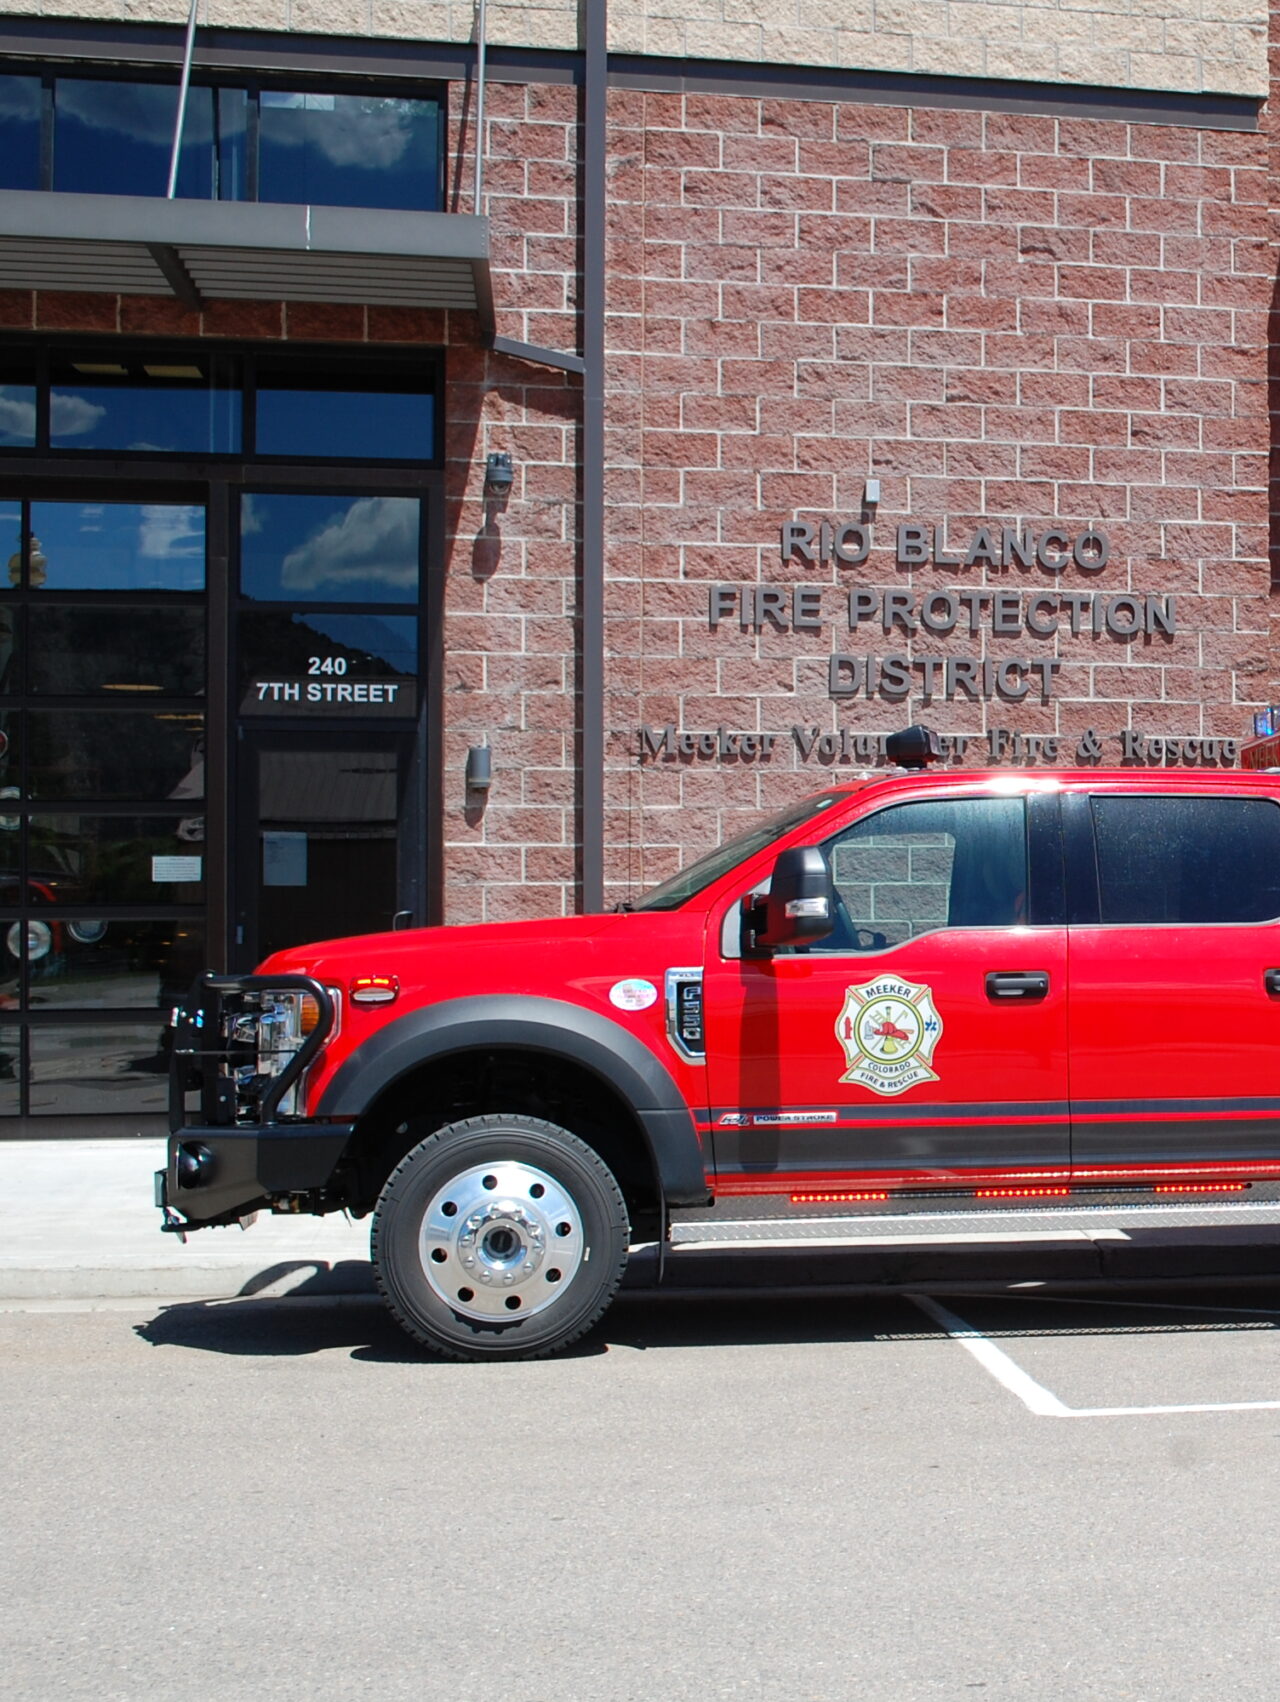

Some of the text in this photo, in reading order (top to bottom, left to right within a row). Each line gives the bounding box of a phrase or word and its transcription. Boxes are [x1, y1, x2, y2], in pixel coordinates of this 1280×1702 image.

[782, 521, 1110, 570] RIO BLANCO
[708, 585, 1178, 636] FIRE PROTECTION
[307, 656, 347, 676] 240
[829, 653, 1062, 697] DISTRICT
[256, 682, 398, 703] 7TH STREET
[640, 724, 1238, 760] Meeker Voluer Fire & Rescue
[865, 984, 912, 998] MEEKER
[867, 1061, 911, 1074] COLORADO
[860, 1072, 879, 1085] FIRE
[887, 1070, 919, 1089] RESCUE
